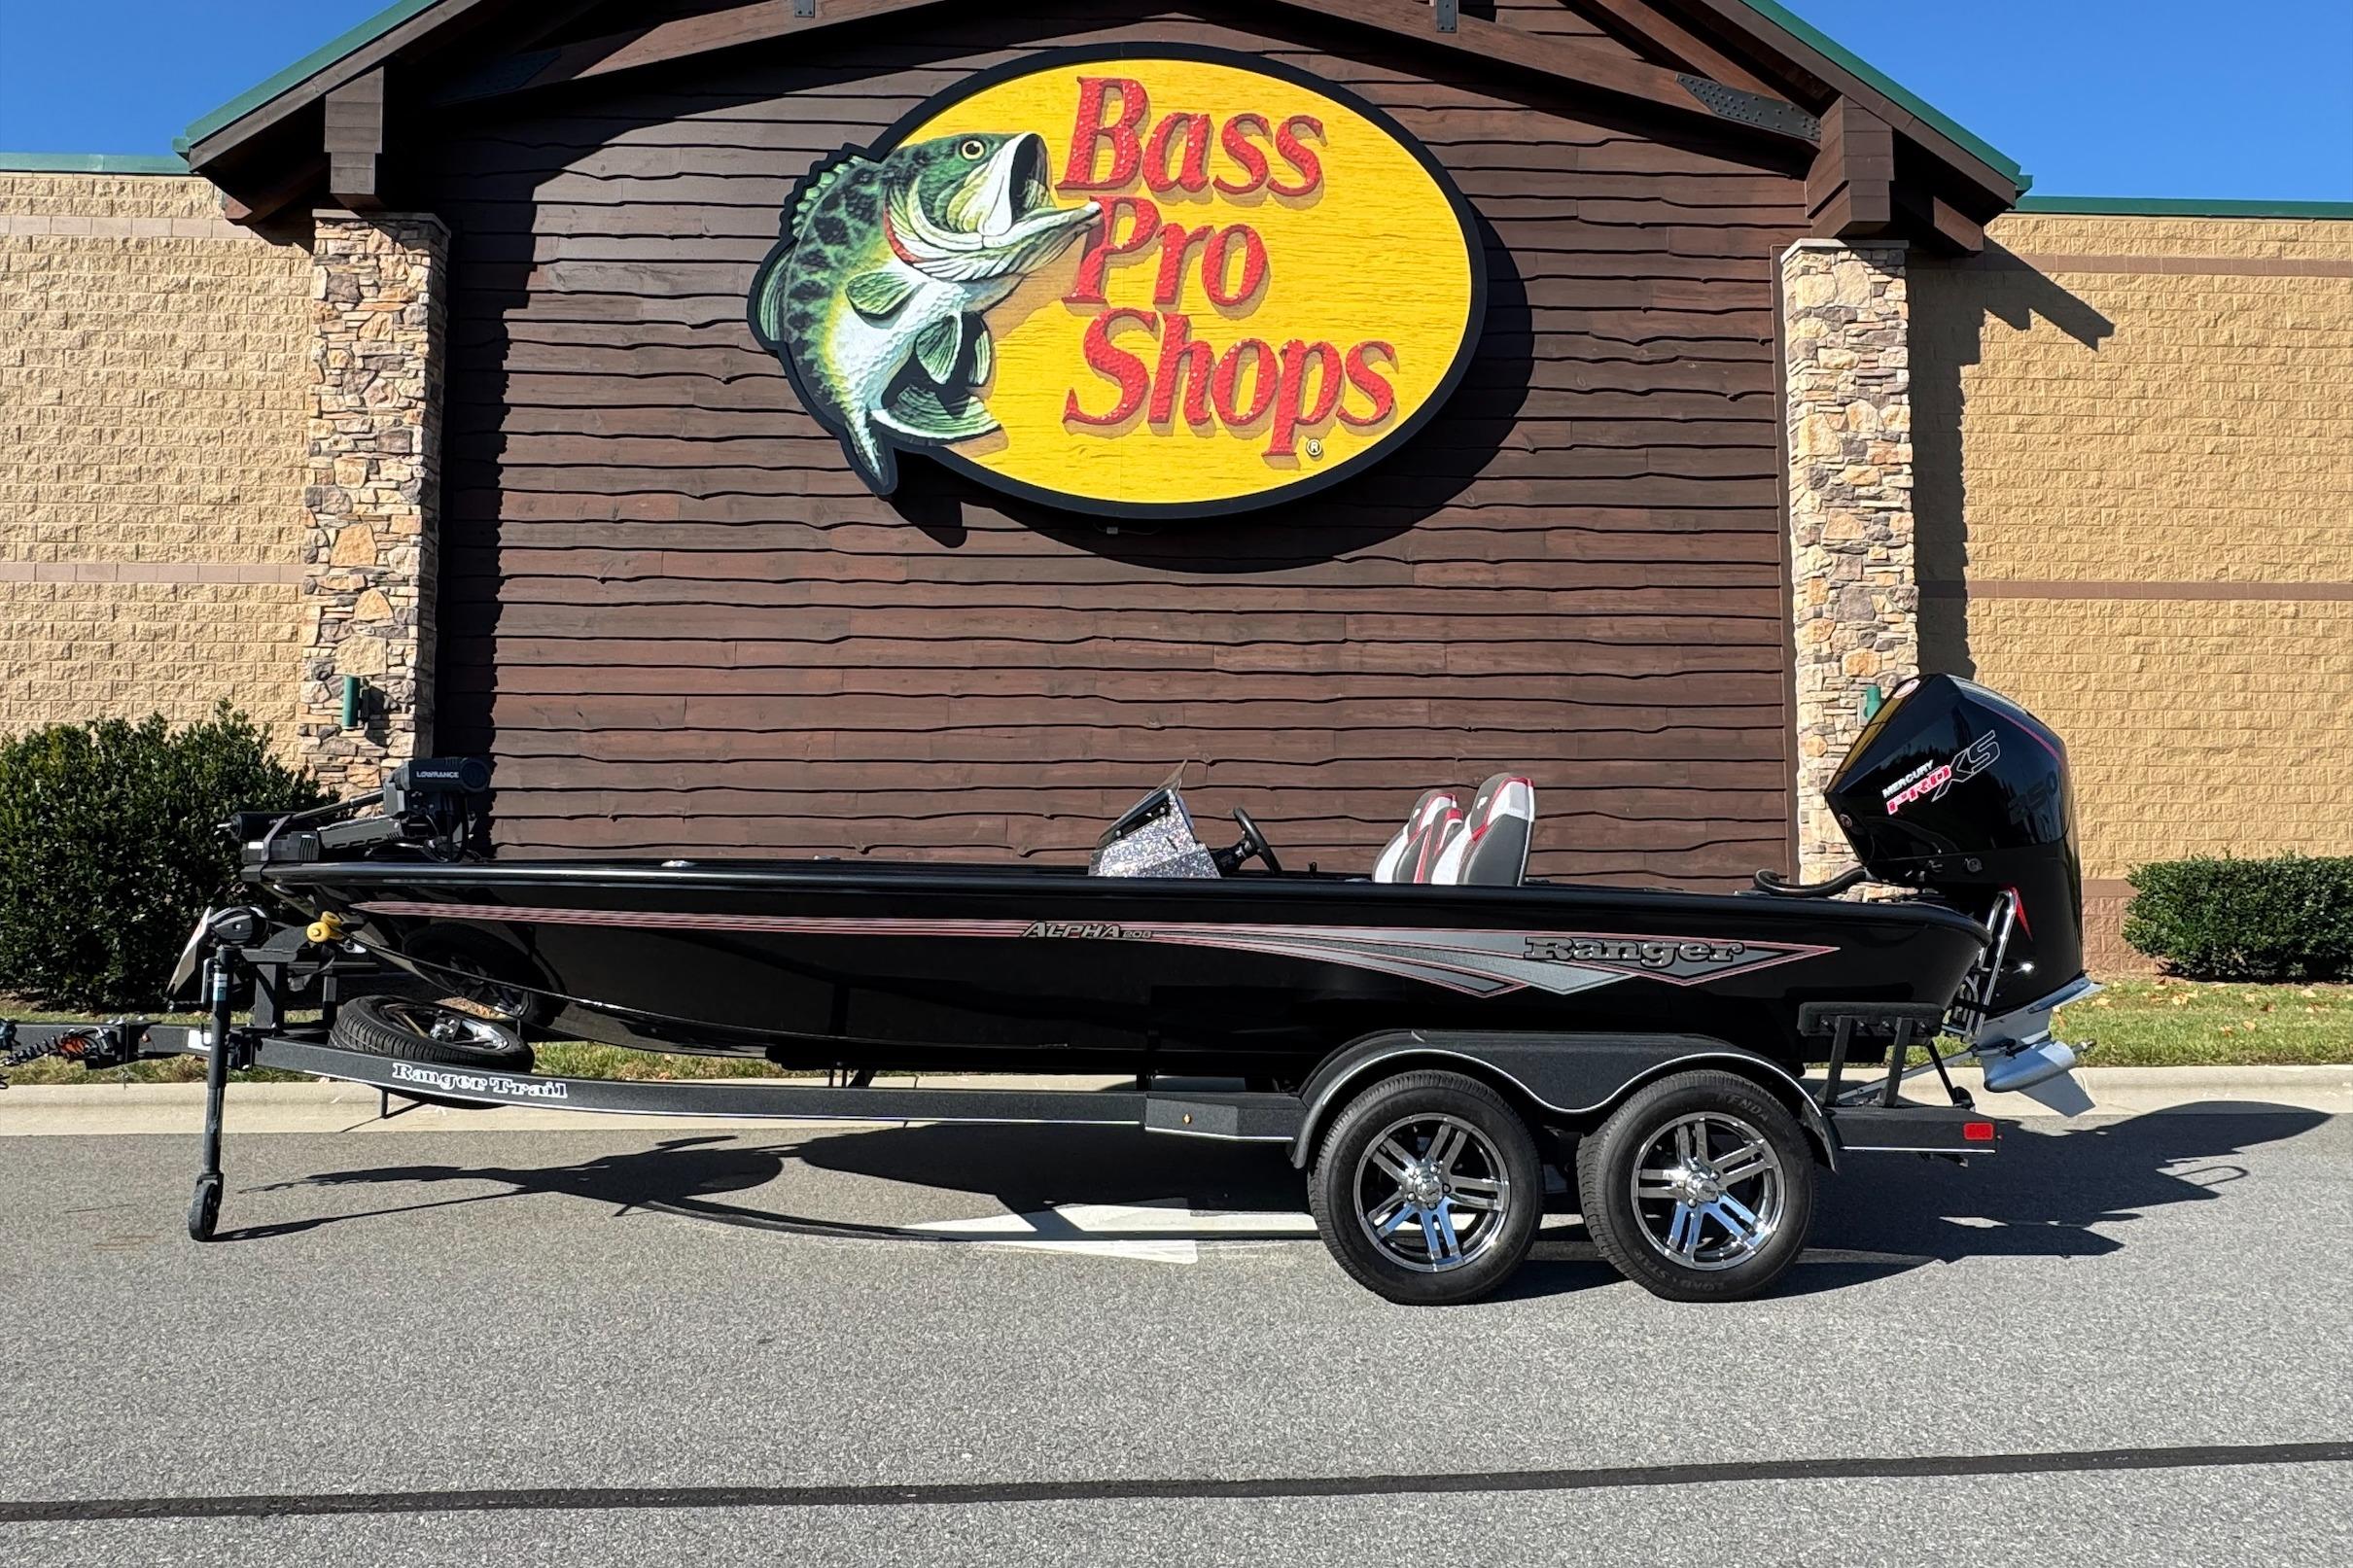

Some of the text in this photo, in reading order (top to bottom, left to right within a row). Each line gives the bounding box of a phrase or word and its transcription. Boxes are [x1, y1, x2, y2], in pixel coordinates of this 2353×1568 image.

[1055, 76, 1324, 197] Bass
[1061, 195, 1268, 307] Pro
[1062, 307, 1396, 457] Shops
[416, 770, 460, 779] LOWRANCE
[1882, 759, 1935, 799] MERCURY
[1021, 922, 1120, 939] ALPHA
[1524, 936, 1745, 969] Ranger
[392, 1063, 569, 1099] Ranger Trail
